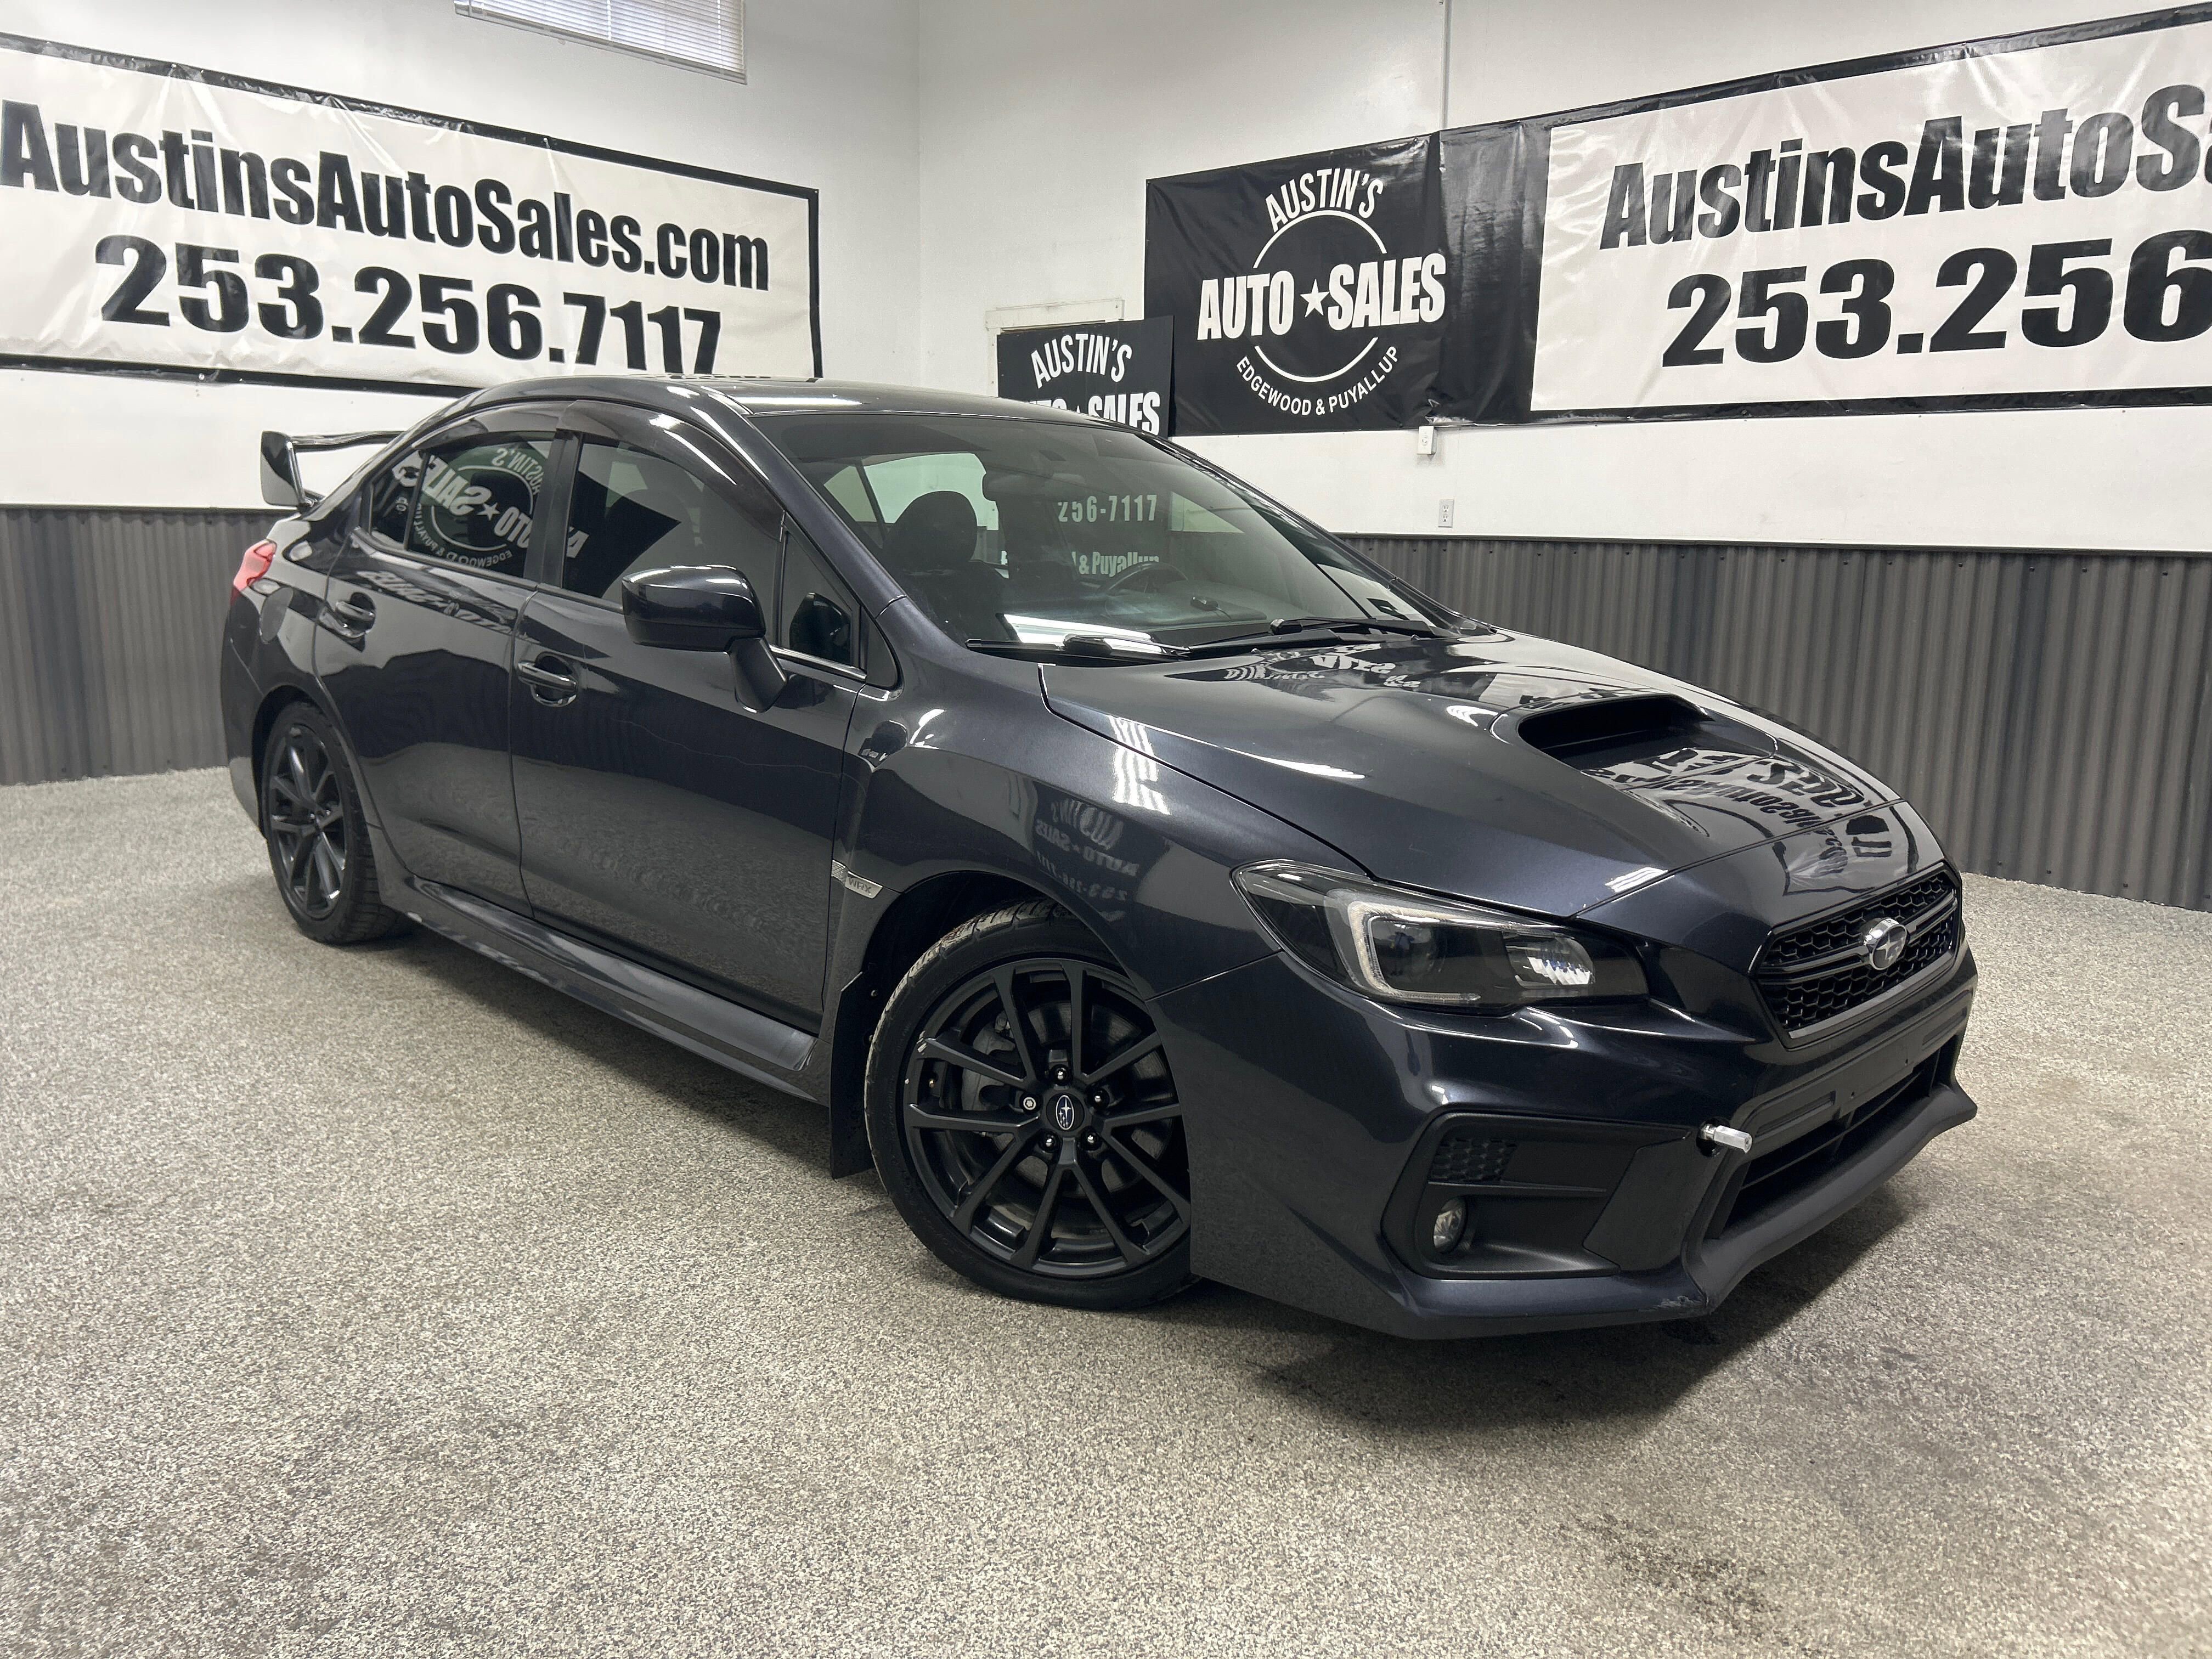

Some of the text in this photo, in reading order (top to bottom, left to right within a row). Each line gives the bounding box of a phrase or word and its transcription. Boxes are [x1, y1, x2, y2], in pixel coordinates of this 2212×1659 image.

[1, 101, 769, 291] AustinsAutoSales.com
[1265, 167, 1386, 233] AUSTIN'S
[1600, 84, 2212, 250] AustinsAutoS
[95, 235, 721, 375] 253.256.7117
[1197, 253, 1446, 340] AUTO SALES
[1031, 332, 1132, 389] AUSTIN'S
[1236, 346, 1398, 415] EDGEWOOD & PUYALLUP
[848, 878, 871, 894] WRX
